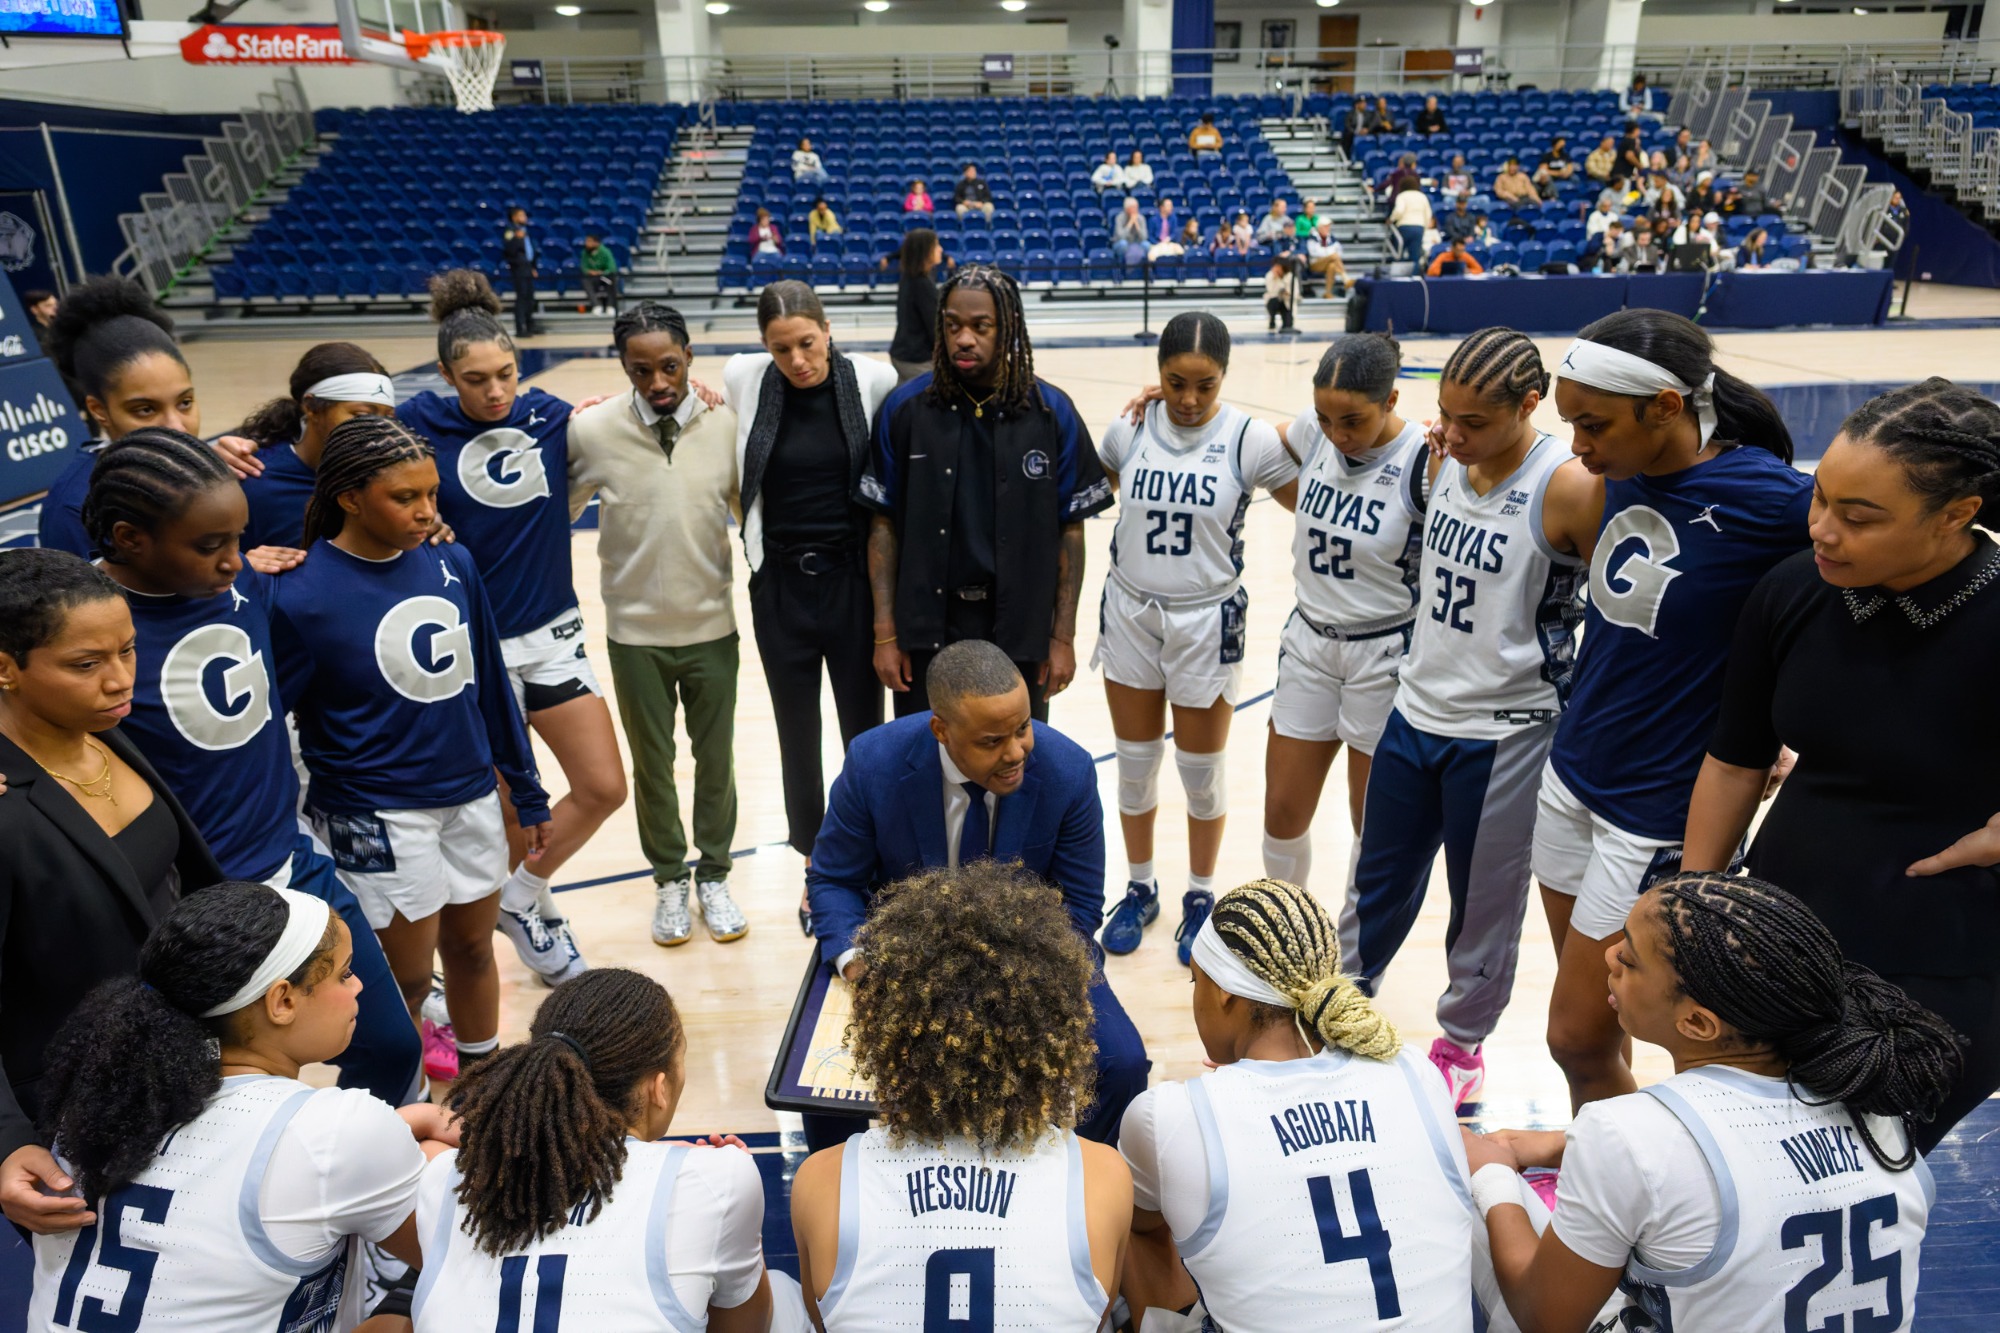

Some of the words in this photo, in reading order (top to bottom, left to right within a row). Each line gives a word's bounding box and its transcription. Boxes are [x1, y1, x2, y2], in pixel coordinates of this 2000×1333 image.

[457, 427, 550, 508] G
[1131, 468, 1217, 507] HOYAS
[1146, 510, 1193, 556] 23
[1299, 478, 1386, 536] HOYAS
[1308, 527, 1354, 580] 22
[1426, 509, 1508, 574] HOYAS
[1588, 504, 1683, 638] G
[1431, 566, 1476, 634] 32
[374, 595, 475, 703] G
[160, 623, 272, 750] G
[1270, 1100, 1376, 1157] AGUBATA
[1780, 1126, 1864, 1184] NWEKE
[907, 1165, 1016, 1218] HESSION
[53, 1182, 175, 1333] 15
[1307, 1168, 1402, 1320] 4
[1781, 1192, 1904, 1333] 25
